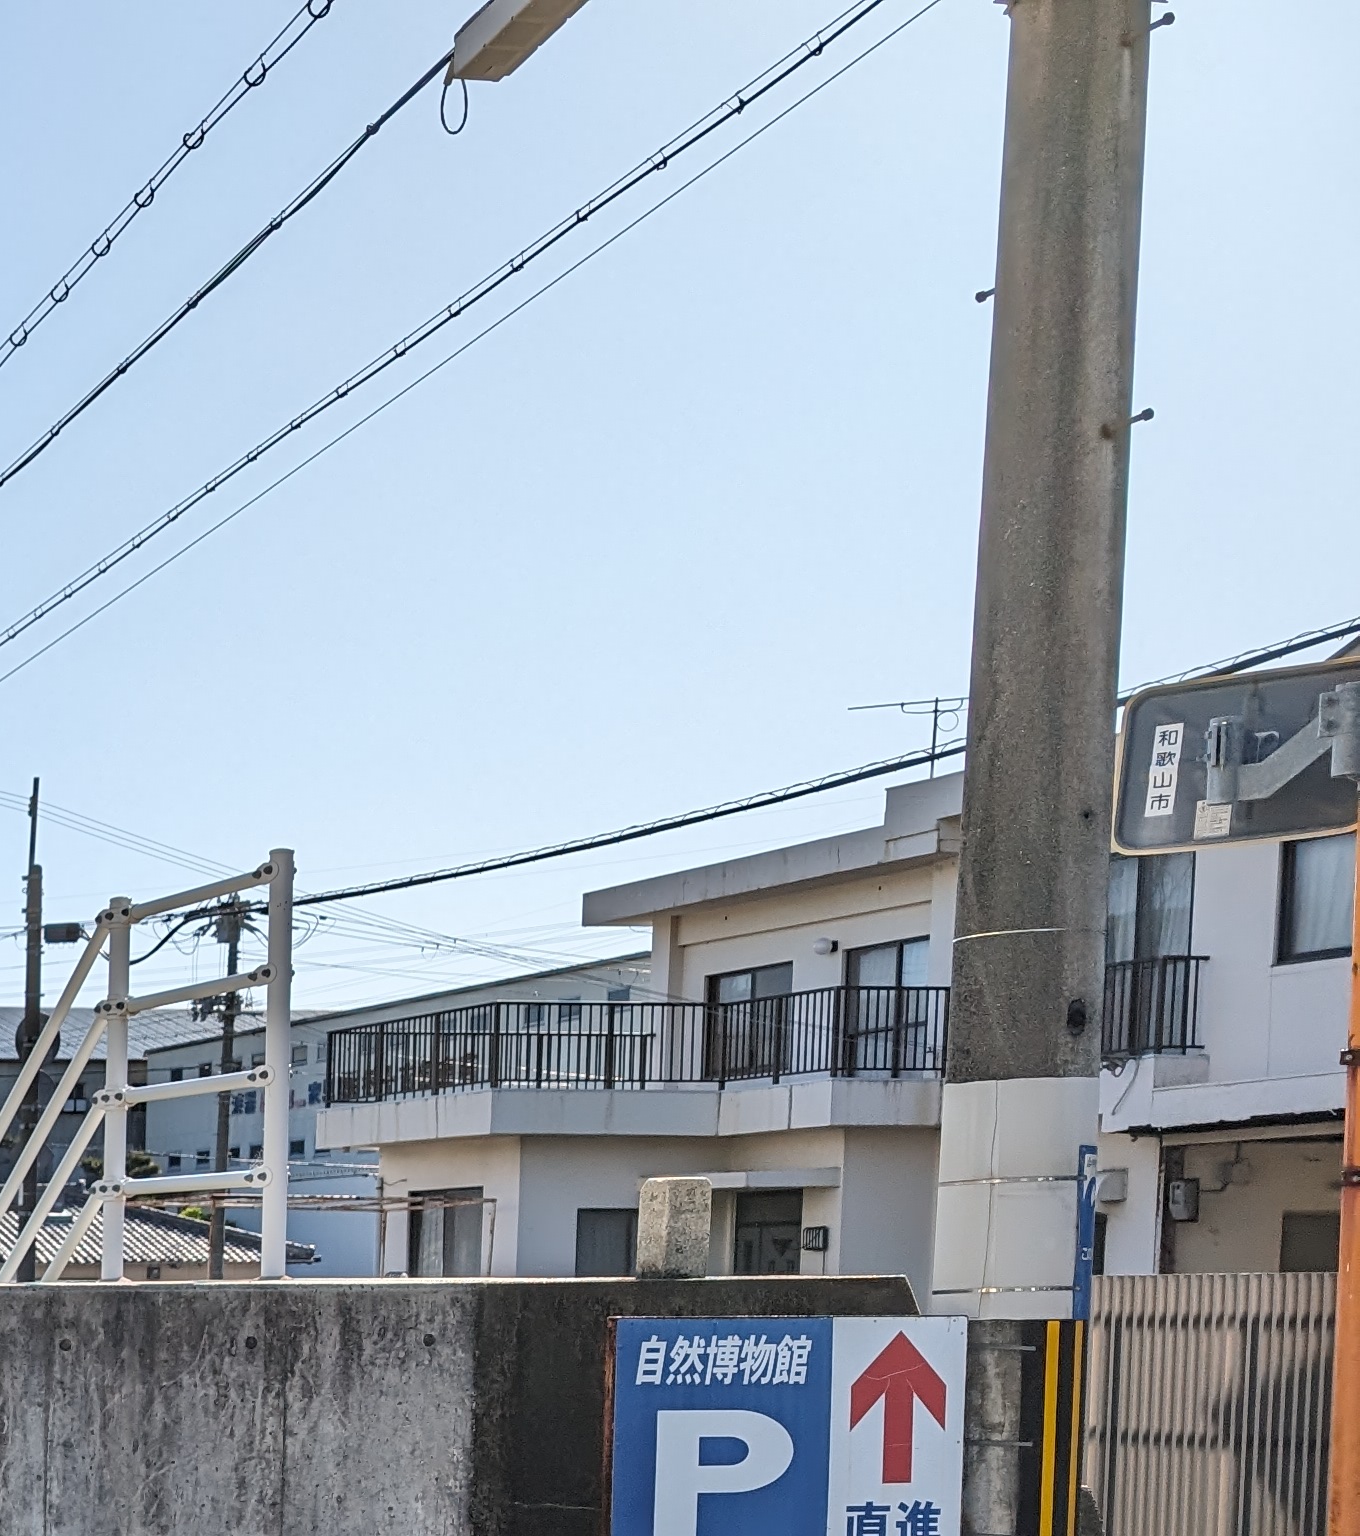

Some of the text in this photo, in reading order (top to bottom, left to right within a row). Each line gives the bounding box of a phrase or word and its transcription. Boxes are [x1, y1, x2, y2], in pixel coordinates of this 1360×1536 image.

[1150, 729, 1178, 811] 和歌山市
[635, 1334, 812, 1385] 自然博物館
